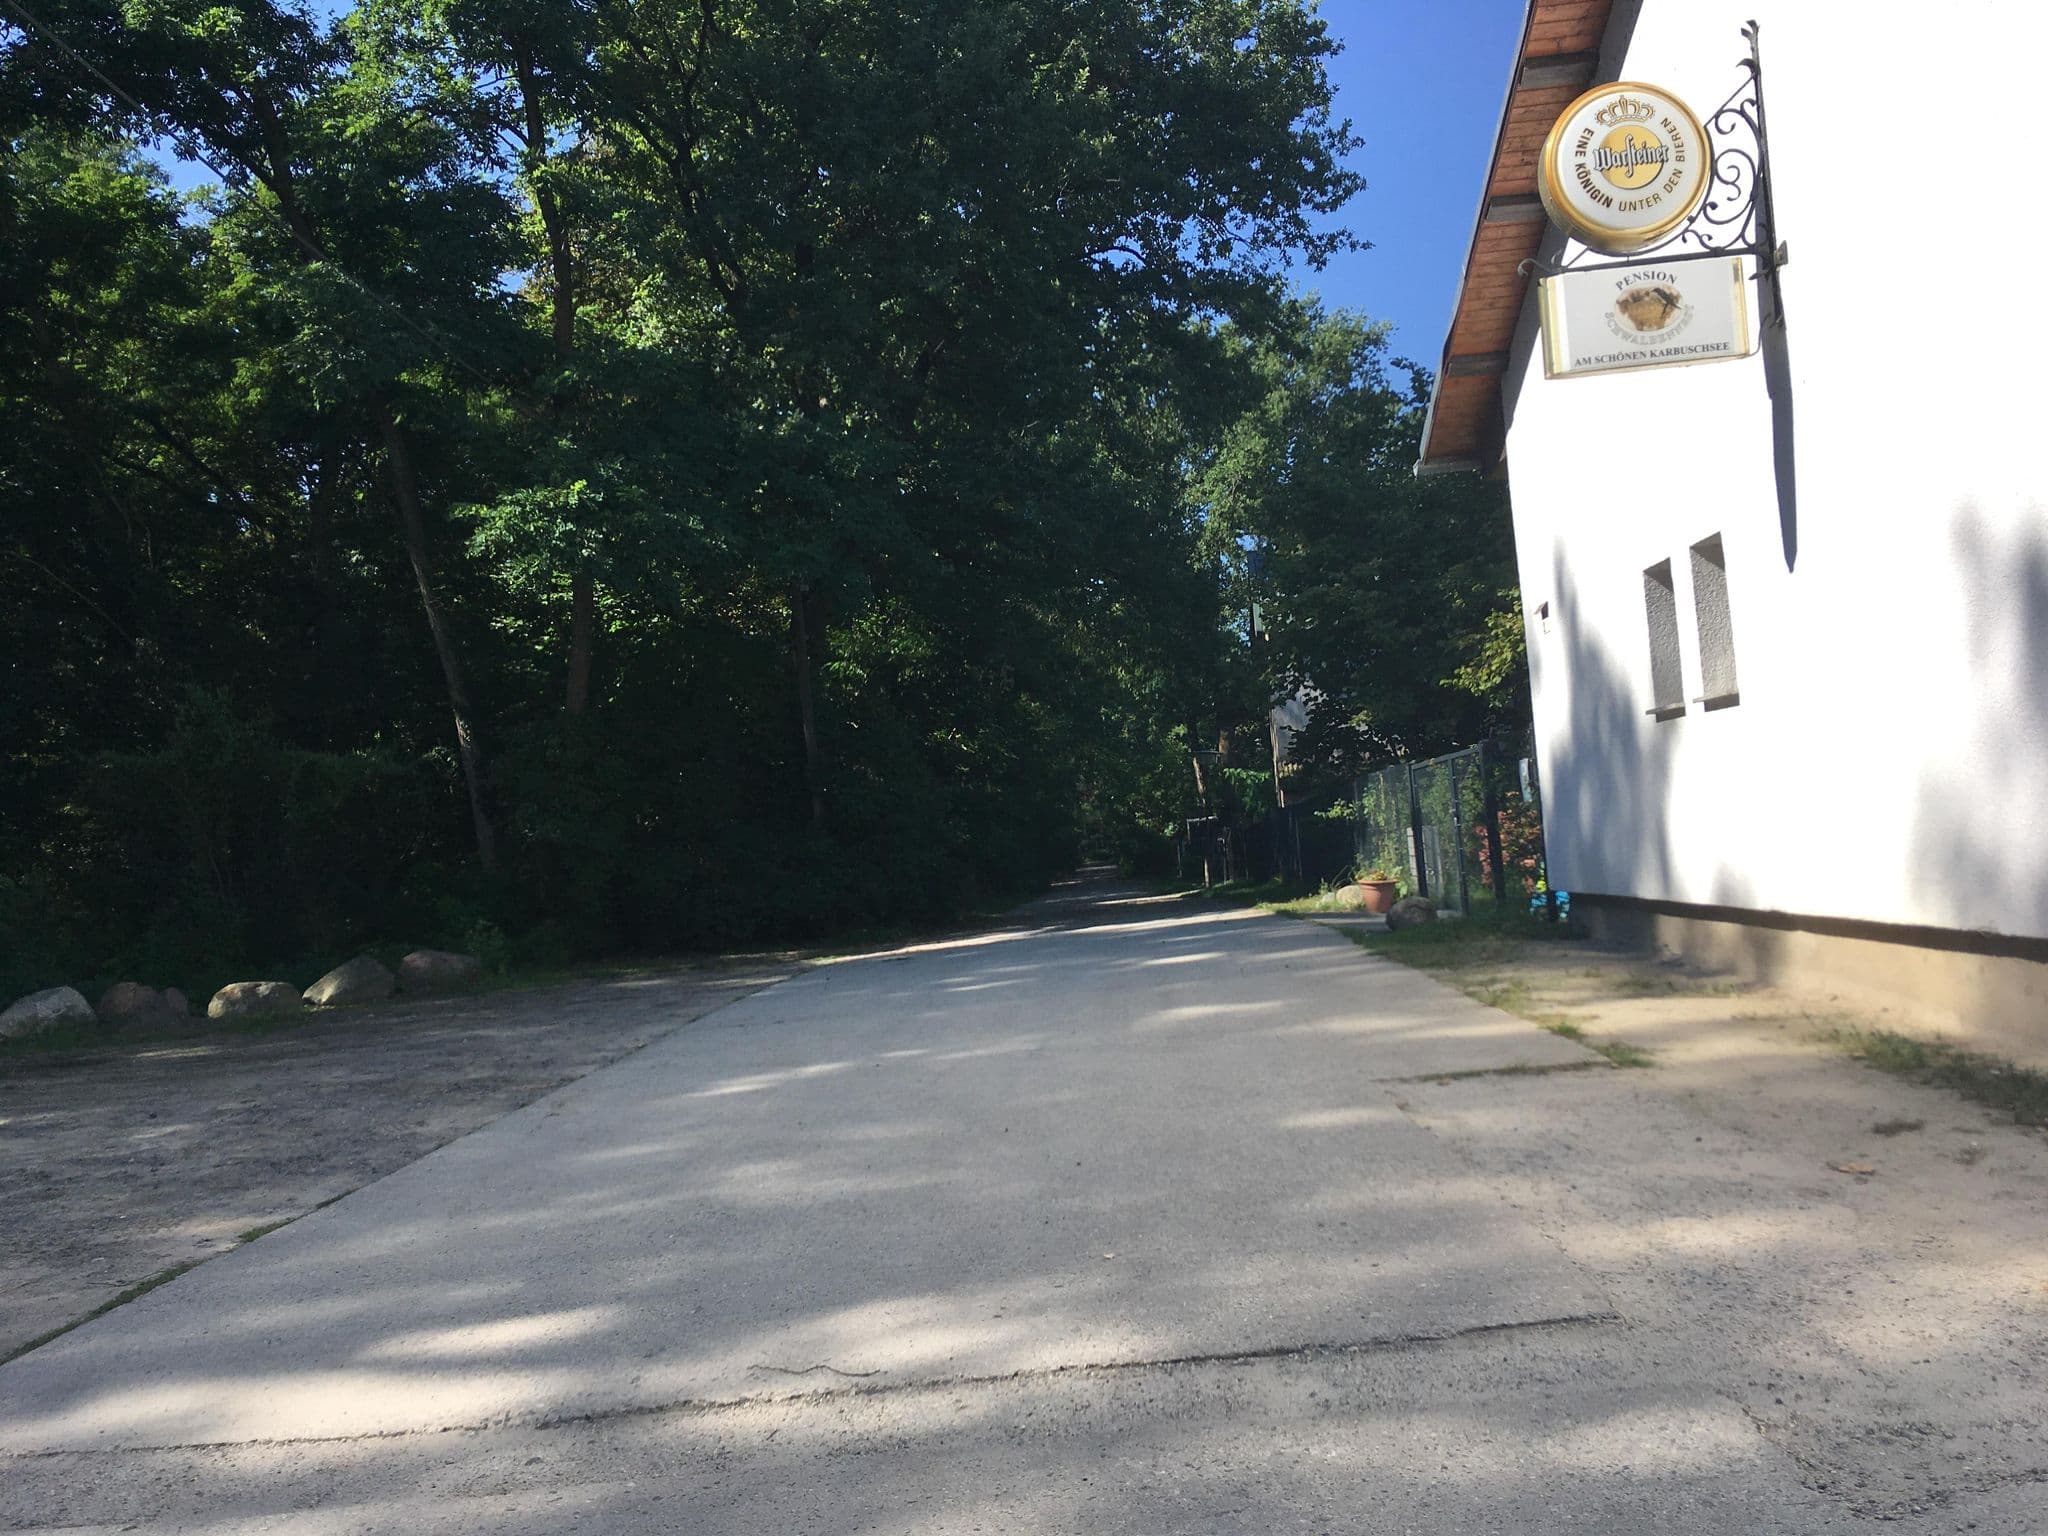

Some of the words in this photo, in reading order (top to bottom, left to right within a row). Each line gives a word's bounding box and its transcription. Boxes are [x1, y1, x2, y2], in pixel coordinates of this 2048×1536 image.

[1575, 127, 1595, 158] EINE
[1660, 117, 1685, 163] BIEREN
[1593, 133, 1670, 178] Warsteiner
[1575, 163, 1614, 209] KÖNIGIN
[1663, 168, 1683, 194] DEN
[1618, 193, 1662, 212] UNTER
[1616, 270, 1678, 290] PENSION
[1575, 358, 1592, 367] AM
[1594, 350, 1648, 366] SCHÖNEN
[1650, 341, 1730, 358] KARBUSCHSEE
